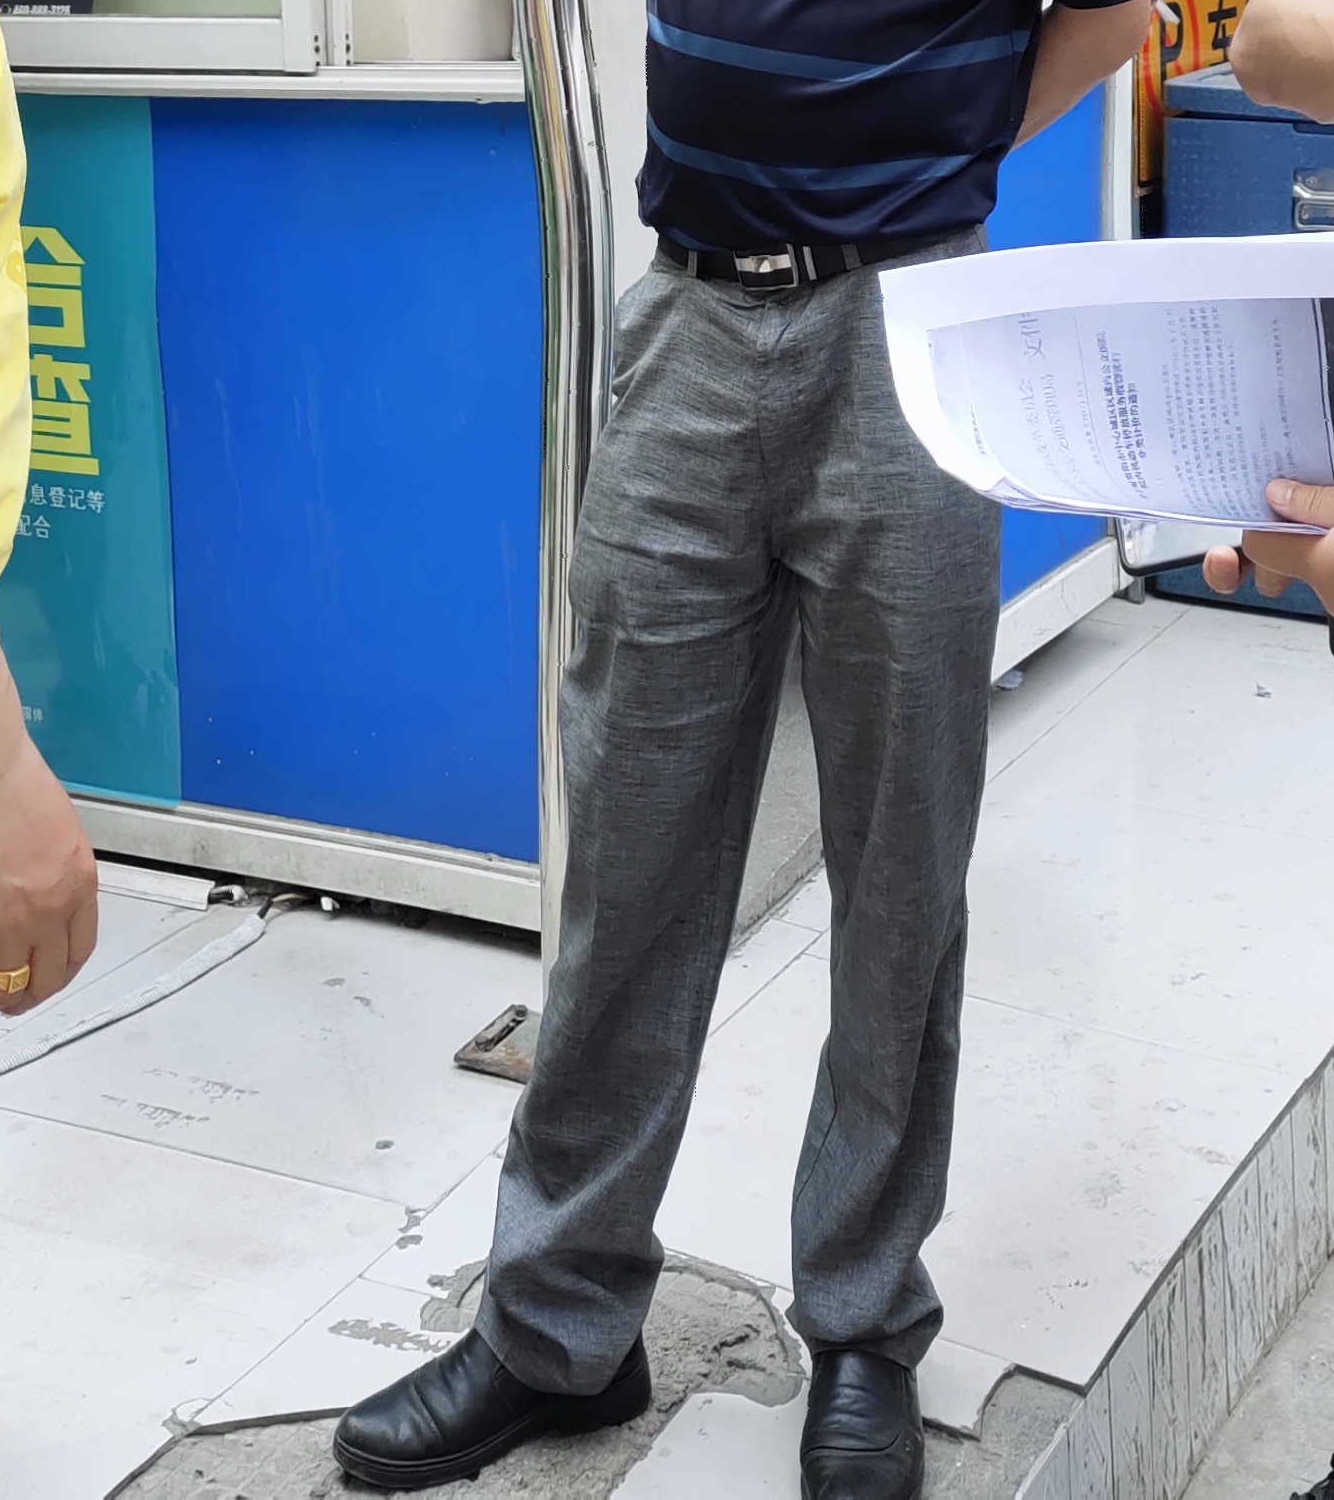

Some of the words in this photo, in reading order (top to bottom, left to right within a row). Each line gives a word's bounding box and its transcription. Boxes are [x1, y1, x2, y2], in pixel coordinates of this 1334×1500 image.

[23, 483, 105, 514] 息登记等
[16, 514, 52, 539] 配合
